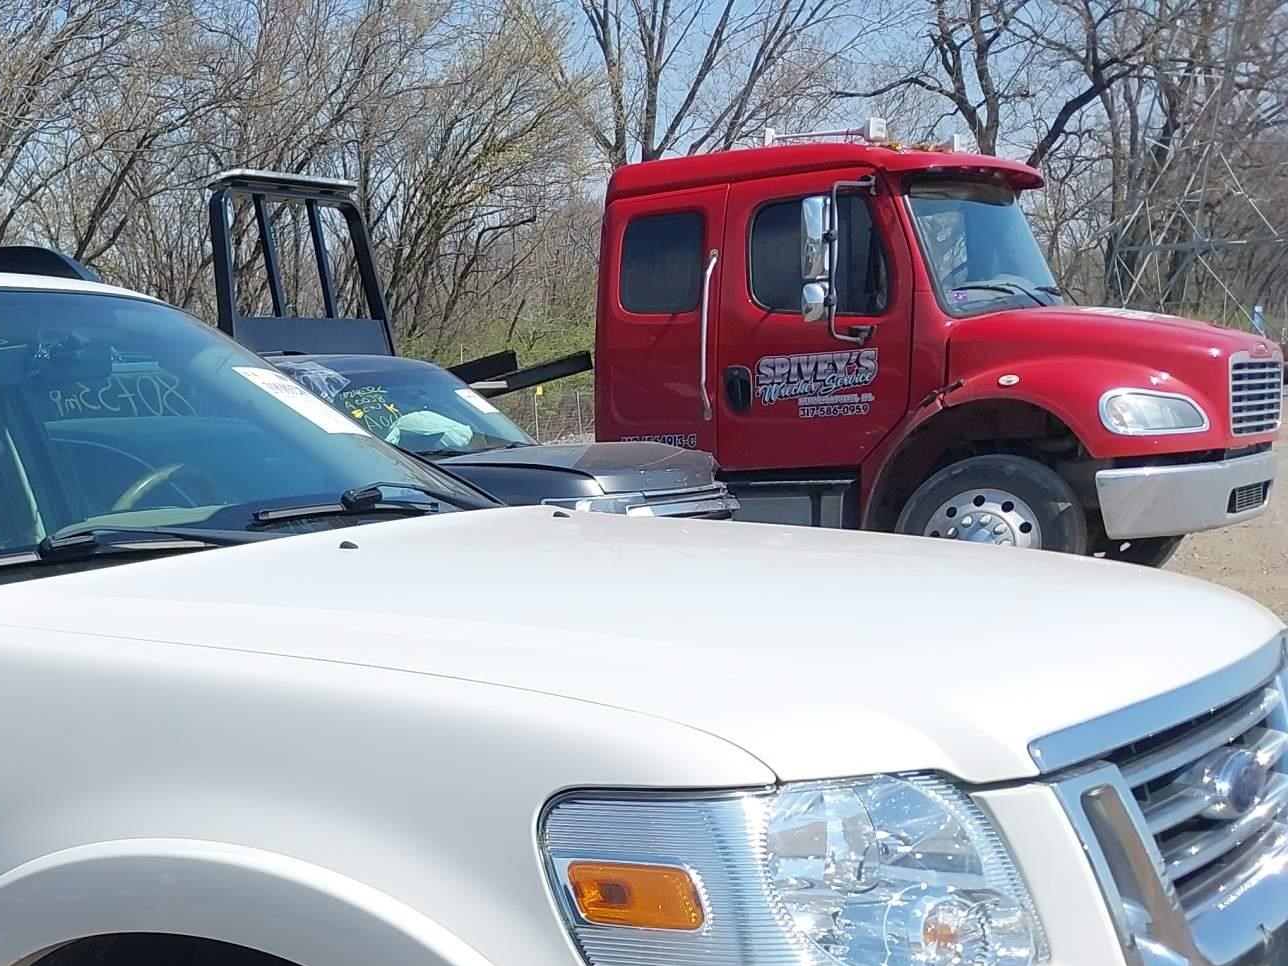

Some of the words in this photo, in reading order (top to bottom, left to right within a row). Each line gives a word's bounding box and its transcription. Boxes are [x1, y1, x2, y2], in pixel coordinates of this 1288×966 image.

[756, 348, 878, 385] SPIVEY'S
[824, 371, 874, 394] Service
[799, 403, 870, 418] 317-586-0959
